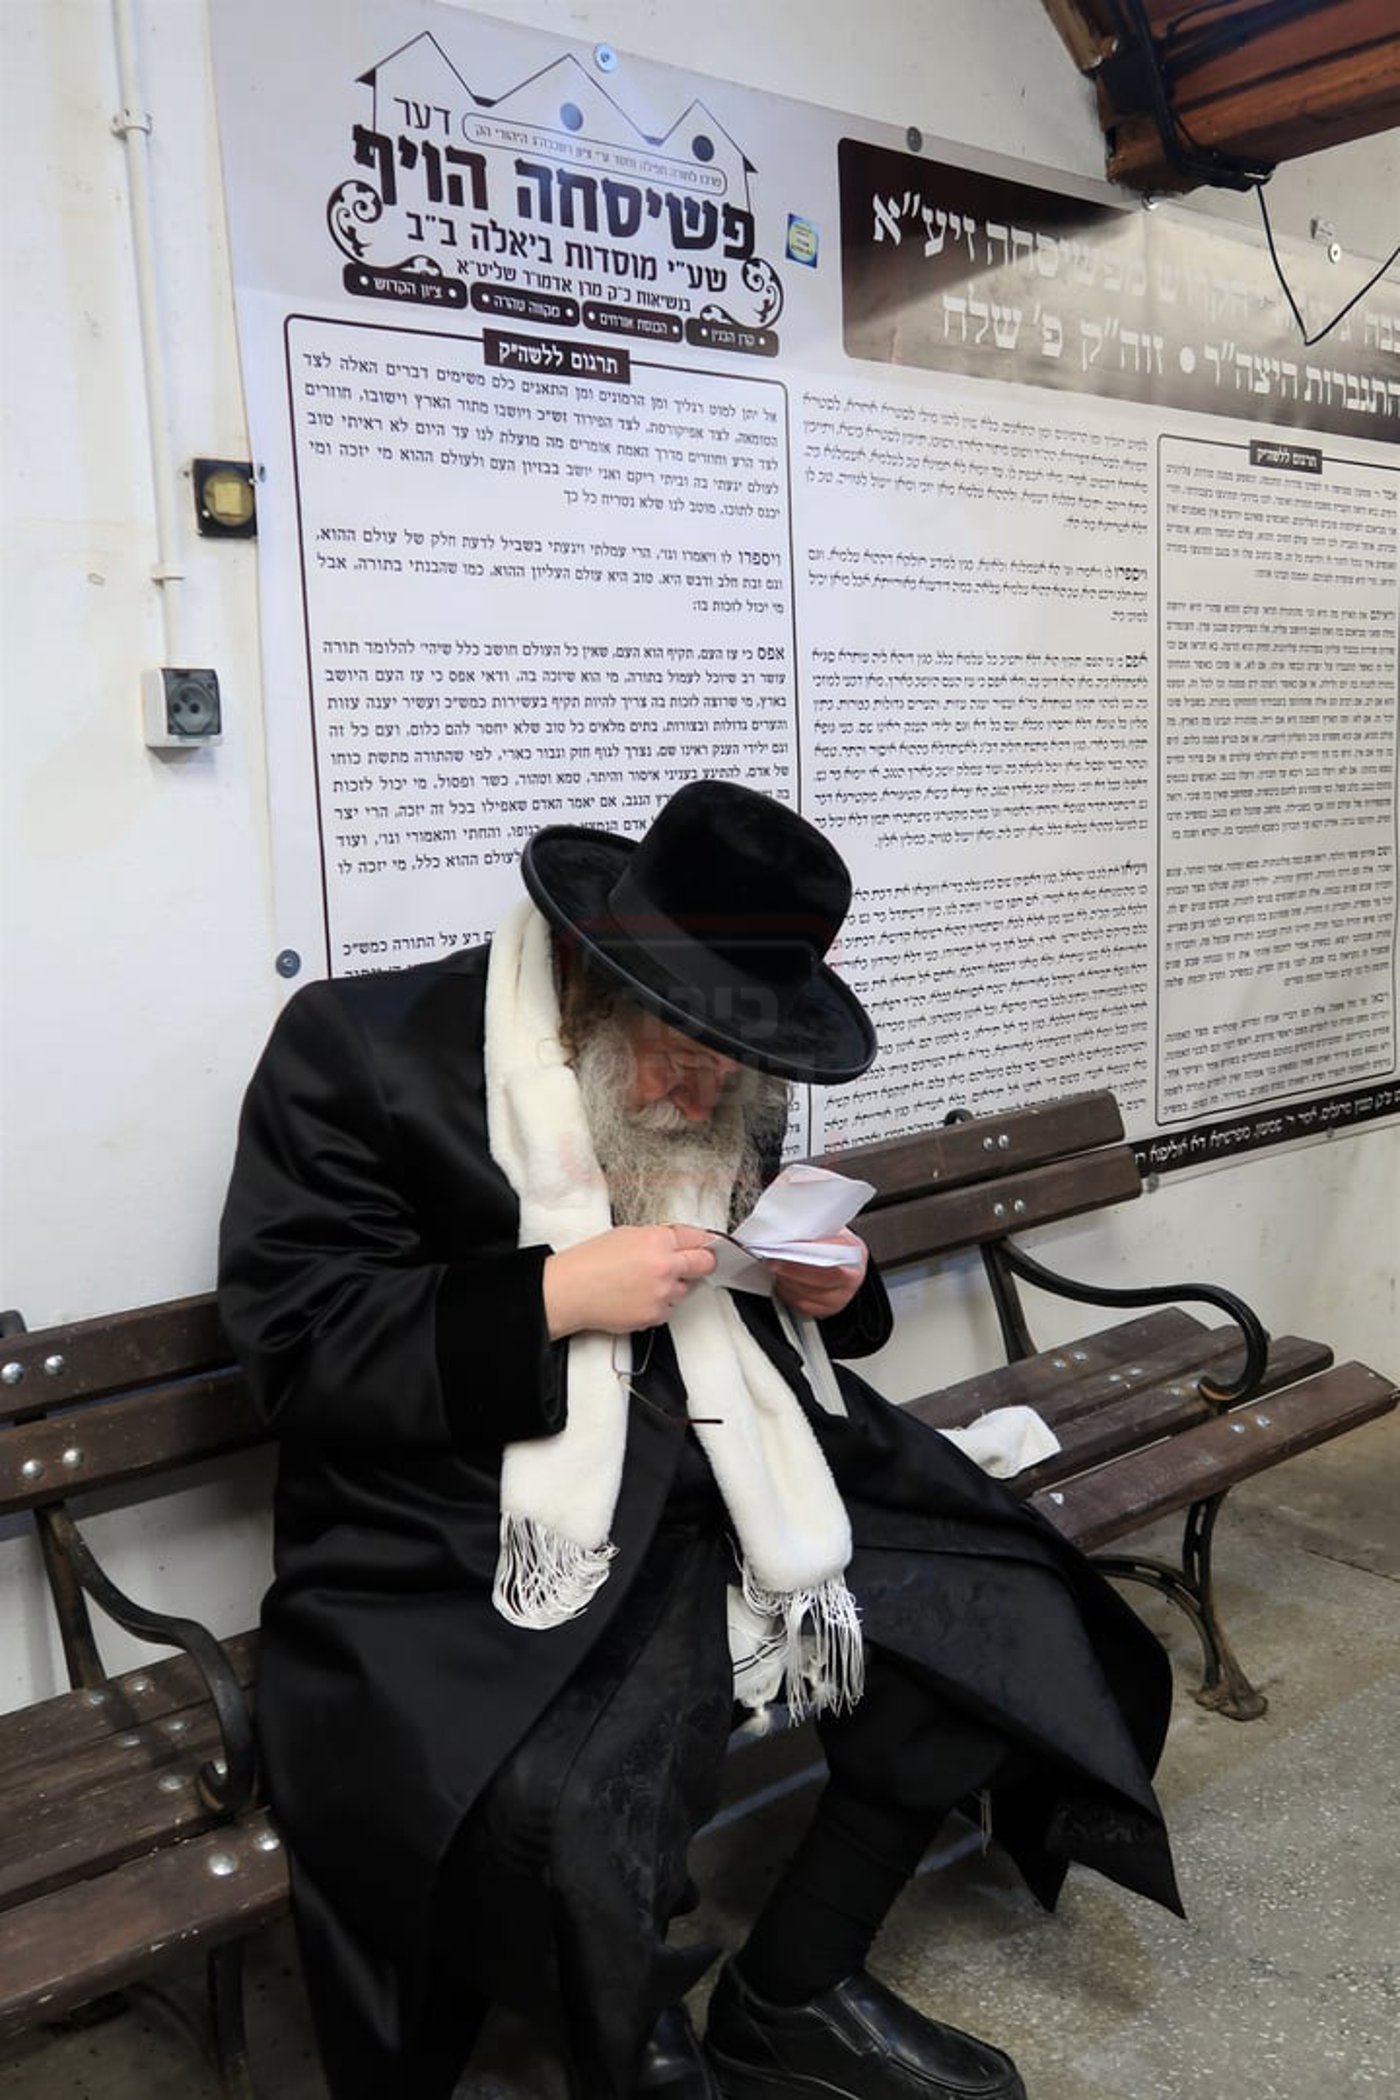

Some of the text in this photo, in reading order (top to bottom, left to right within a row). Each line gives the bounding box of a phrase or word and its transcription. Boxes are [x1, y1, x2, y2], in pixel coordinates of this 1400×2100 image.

[394, 97, 451, 135] דער
[352, 124, 756, 261] פשיסחה הויף
[872, 191, 976, 263] זיע"א
[405, 211, 727, 293] שע"י מוסדות ביאלה ב"ב
[373, 277, 417, 297] הקדוש
[456, 258, 691, 313] בנשיאות כ"ק מרן אדמו"ר שליט"א
[942, 282, 1023, 350] שלח
[1032, 302, 1064, 359] פ'
[1079, 315, 1164, 375] זוה"ק
[498, 340, 619, 375] תרגום ללשה"ק
[302, 351, 569, 397] התאנים כלם משימים דברים האלה לצד
[304, 382, 352, 400] חוזרים
[413, 394, 452, 410] הארץ
[456, 398, 489, 415] מתור
[306, 411, 335, 427] טוב
[341, 414, 383, 431] ראיתי
[389, 416, 409, 433] לא
[415, 421, 446, 437] היום
[451, 425, 469, 440] עד
[475, 425, 494, 442] לנו
[546, 435, 565, 450] מה
[308, 440, 560, 476] בבזיון העם ולעולם ההוא מי יזכה ומי
[362, 528, 398, 545] עולם
[404, 529, 425, 546] של
[430, 531, 456, 548] חלק
[462, 534, 495, 550] לדעת
[499, 535, 543, 553] בשביל
[316, 553, 347, 570] אבל
[408, 559, 458, 575] שהבנתי
[462, 563, 485, 577] כמו
[530, 564, 571, 581] העליון
[322, 640, 360, 654] תורה
[363, 639, 416, 654] להלומד
[455, 640, 481, 657] כלל
[483, 643, 518, 657] חושב
[522, 641, 561, 658] העולם
[324, 669, 368, 683] היושב
[375, 668, 405, 683] העם
[410, 669, 424, 683] עז
[430, 669, 444, 683] כי
[448, 670, 476, 683] אפס
[480, 670, 510, 683] ודאי
[542, 670, 576, 683] שיזכה
[327, 696, 360, 711] עזות
[365, 696, 398, 710] יענה
[402, 696, 440, 711] ועשיר
[491, 695, 548, 709] בעשירות
[329, 724, 345, 738] זה
[350, 721, 369, 738] כל
[375, 724, 400, 738] ועם
[445, 720, 471, 736] להם
[476, 722, 508, 735] יחסר
[513, 719, 540, 735] שלא
[545, 721, 566, 734] טוב
[368, 751, 409, 765] מתשת
[414, 749, 464, 763] שהתורה
[469, 747, 492, 762] לפי
[536, 747, 566, 760] וגבור
[333, 775, 374, 793] לזכות
[379, 775, 407, 791] יכול
[413, 777, 427, 790] מי
[480, 774, 509, 787] כשר
[364, 805, 389, 819] הרי
[430, 803, 444, 816] זה
[449, 799, 476, 815] בכל
[481, 798, 528, 813] שאפילו
[532, 798, 563, 812] האדם
[333, 807, 359, 821] יצר
[335, 833, 368, 849] ועוד
[405, 829, 457, 843] והאמורי
[462, 826, 502, 841] והחתי
[337, 858, 353, 875] לו
[357, 860, 387, 874] יזכה
[392, 858, 407, 872] מי
[445, 854, 479, 868] ההוא
[392, 935, 436, 951] התורה
[439, 931, 458, 947] על
[462, 932, 481, 948] רע
